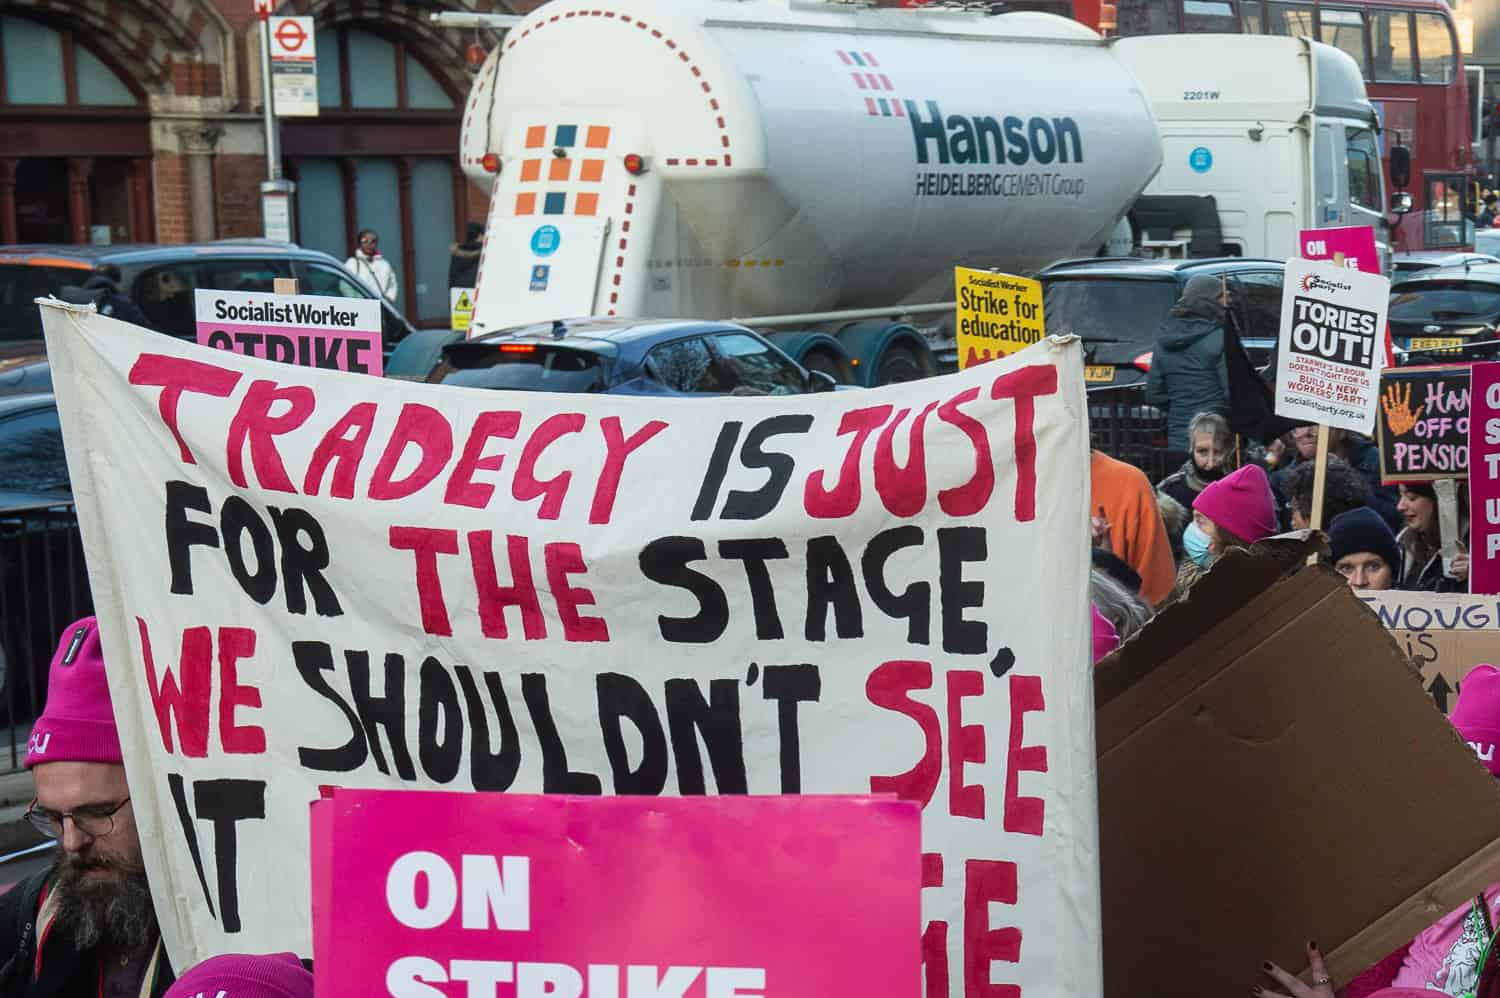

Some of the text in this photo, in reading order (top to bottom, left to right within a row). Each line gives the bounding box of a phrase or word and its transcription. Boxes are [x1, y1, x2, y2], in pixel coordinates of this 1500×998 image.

[904, 99, 1084, 166] Hanson
[1306, 240, 1327, 256] ON
[215, 299, 359, 327] Socialist Worker
[960, 286, 1039, 321] Strike for
[1295, 299, 1376, 336] TORIES
[961, 314, 1040, 344] education
[1292, 322, 1374, 365] OUT!
[1299, 374, 1325, 390] BUILD
[1336, 384, 1359, 396] NEW
[1336, 391, 1369, 408] PARTY
[129, 353, 1059, 525] TRADEGY IS JUST
[1414, 416, 1455, 439] OFF
[166, 479, 1016, 678] FOR THE STAGE,
[136, 615, 1047, 837] WE SHOULDN'T SEE
[167, 772, 266, 934] IT
[386, 850, 531, 931] ON
